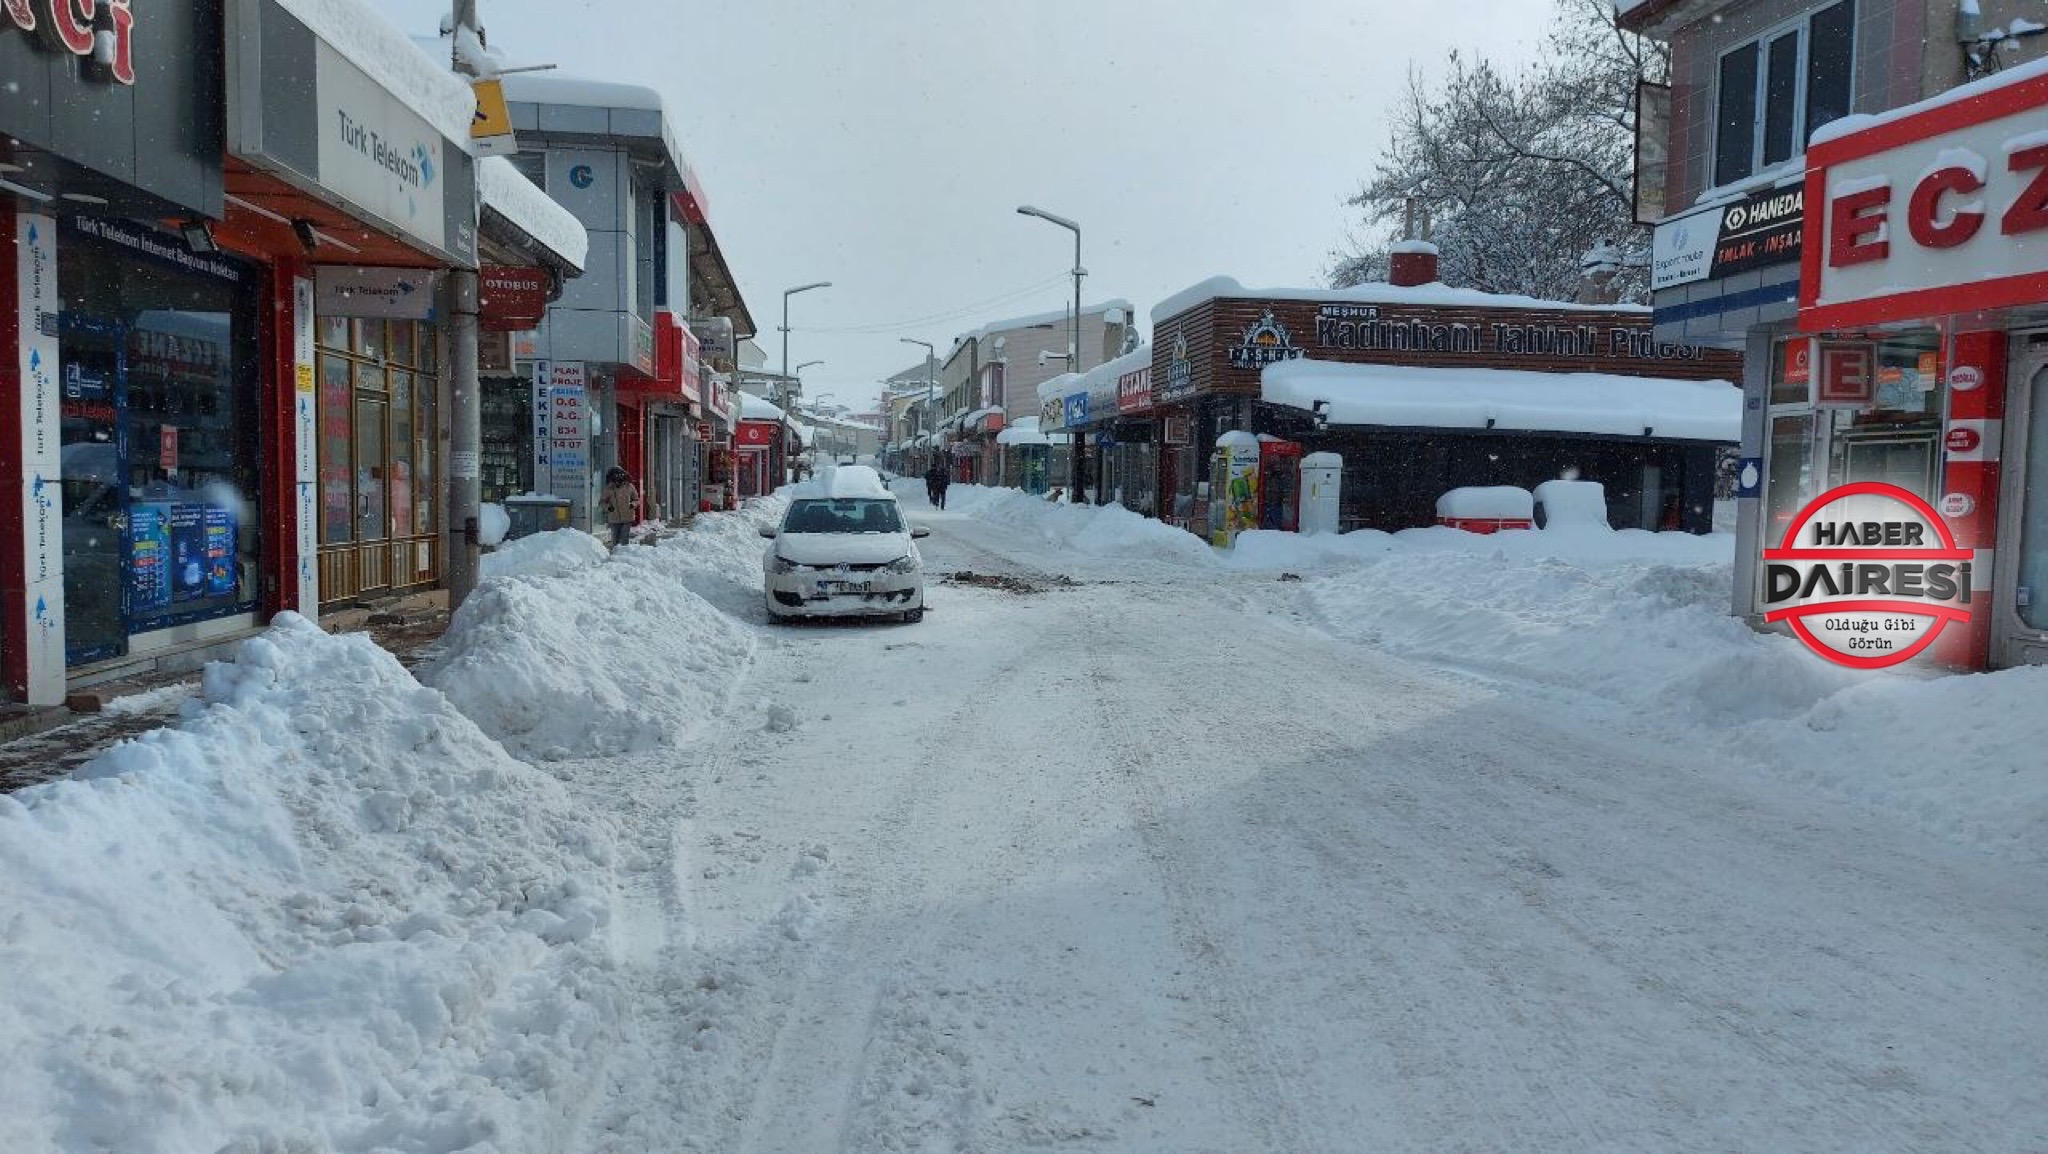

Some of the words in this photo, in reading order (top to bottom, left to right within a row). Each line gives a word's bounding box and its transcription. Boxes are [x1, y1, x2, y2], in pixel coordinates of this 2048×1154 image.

[338, 109, 367, 154] Türk
[370, 131, 419, 188] Telekom
[76, 215, 99, 235] Türk
[100, 222, 140, 249] Telekom
[1718, 241, 1756, 264] EMLAK
[334, 285, 356, 295] Türk
[358, 286, 399, 296] Telekom
[1321, 306, 1377, 318] MEŞHUR
[554, 367, 580, 375] PLAN
